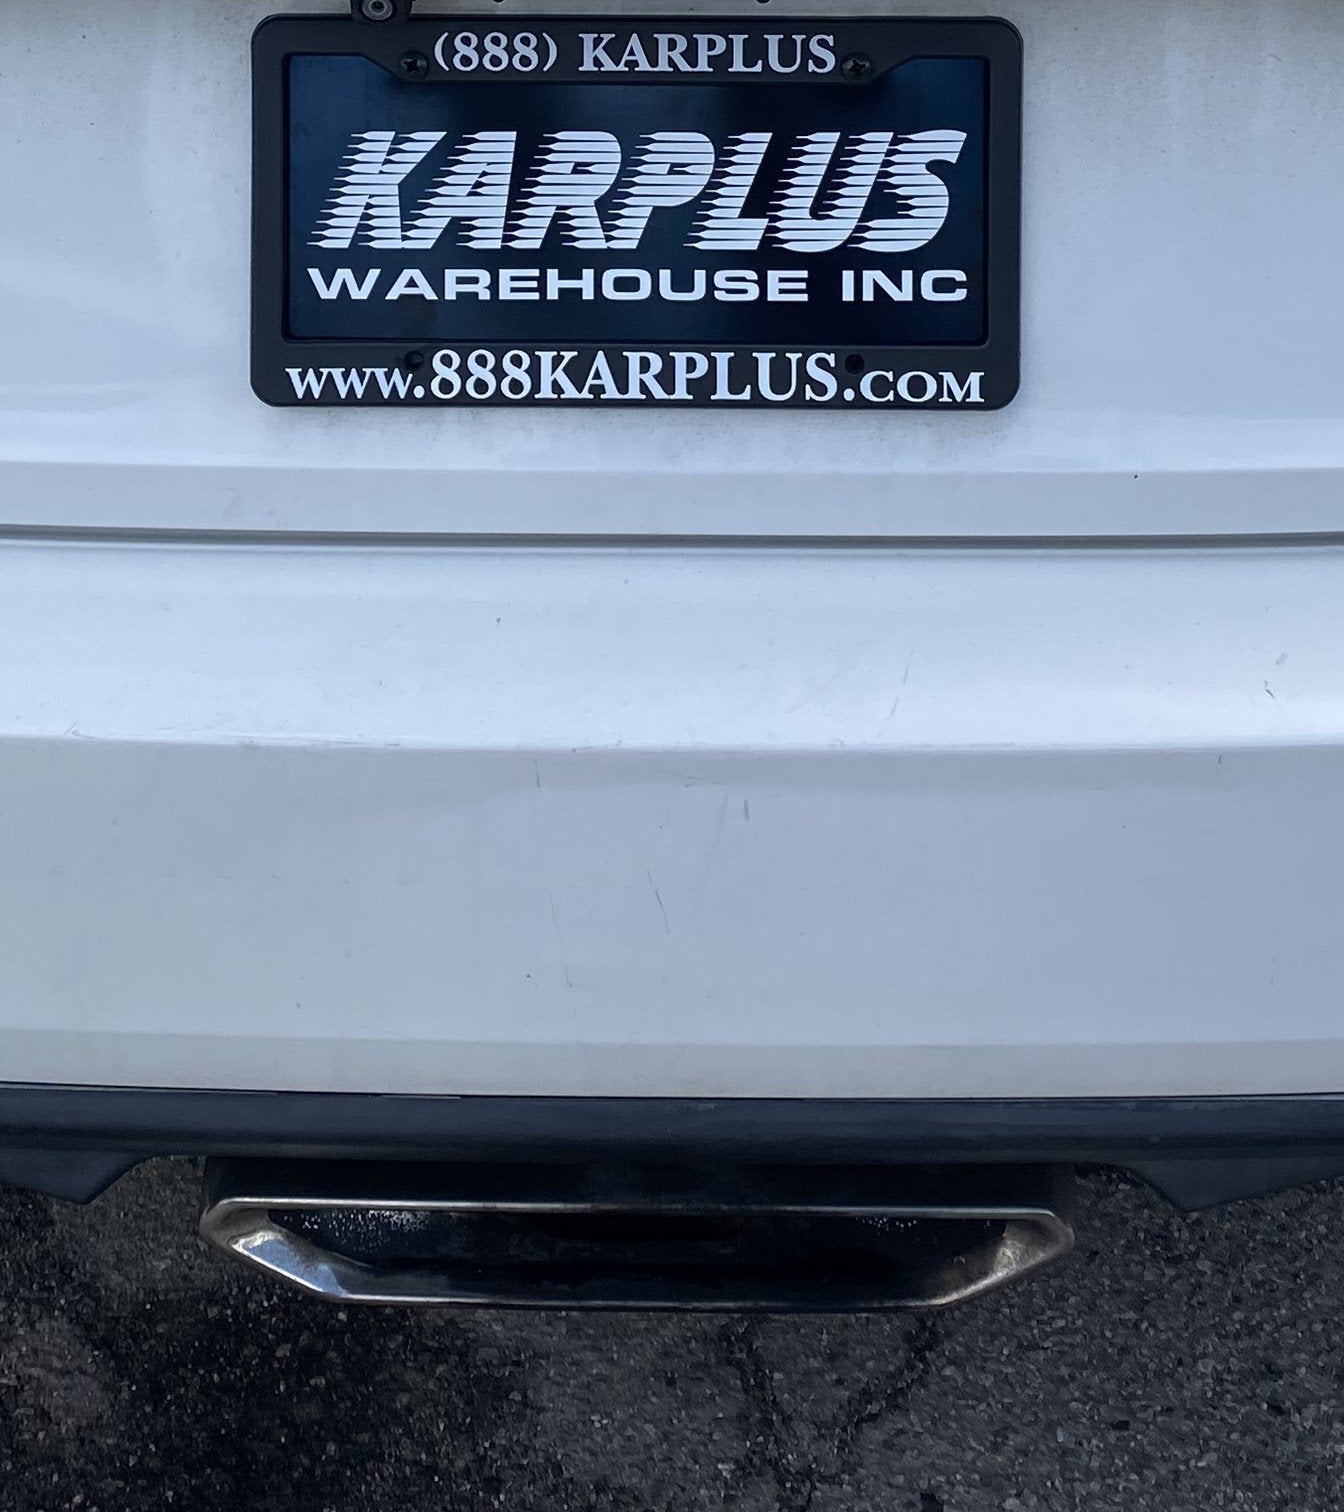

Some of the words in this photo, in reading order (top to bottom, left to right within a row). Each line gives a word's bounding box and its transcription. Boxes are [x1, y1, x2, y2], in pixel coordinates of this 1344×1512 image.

[433, 32, 559, 74] (888)
[578, 33, 836, 74] KARPLUS
[306, 129, 968, 253] KARPLUS
[307, 267, 809, 302] WAREHOUSE
[841, 268, 968, 302] INC
